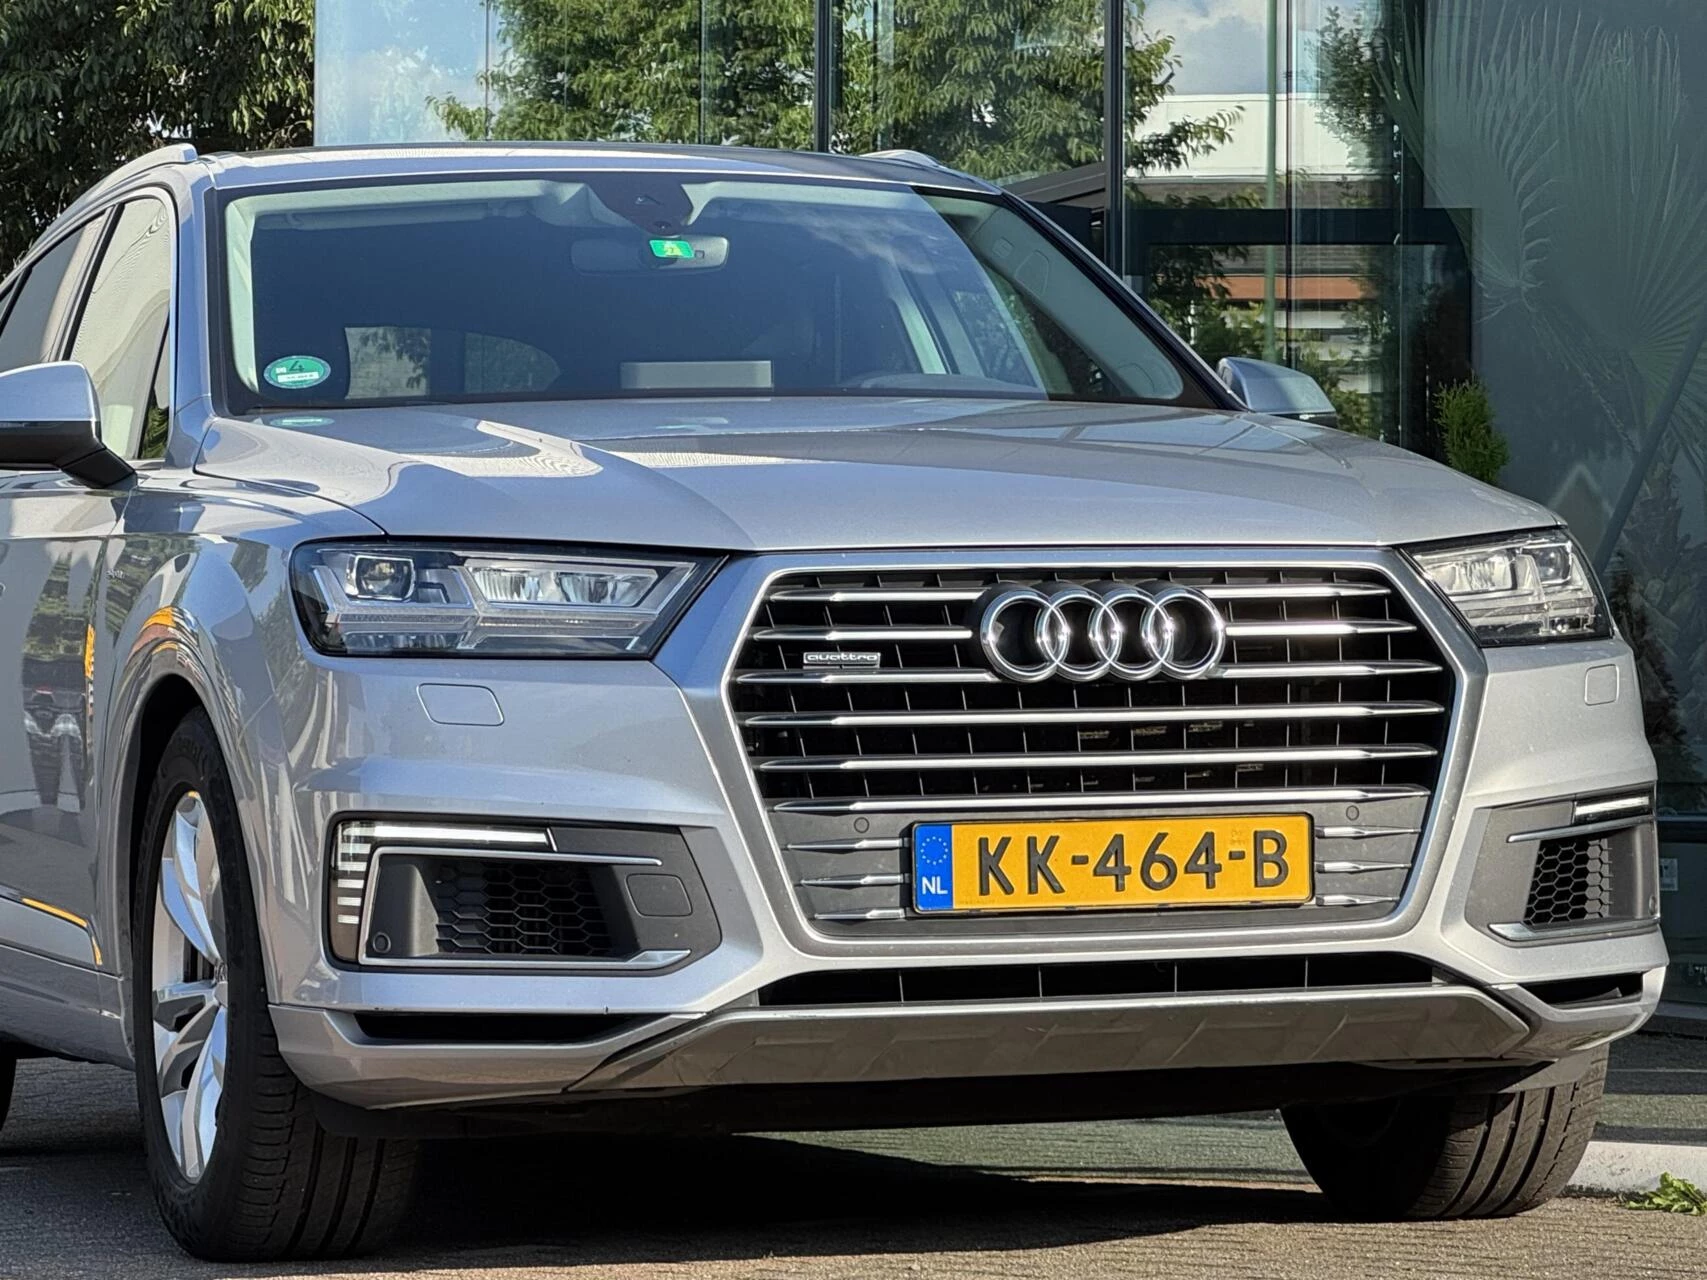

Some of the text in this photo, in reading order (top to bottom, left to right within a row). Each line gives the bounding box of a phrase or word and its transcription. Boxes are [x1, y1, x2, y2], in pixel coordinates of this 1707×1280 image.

[807, 652, 878, 661] quattro
[978, 830, 1290, 896] KK-464-B
[921, 876, 948, 895] NL
